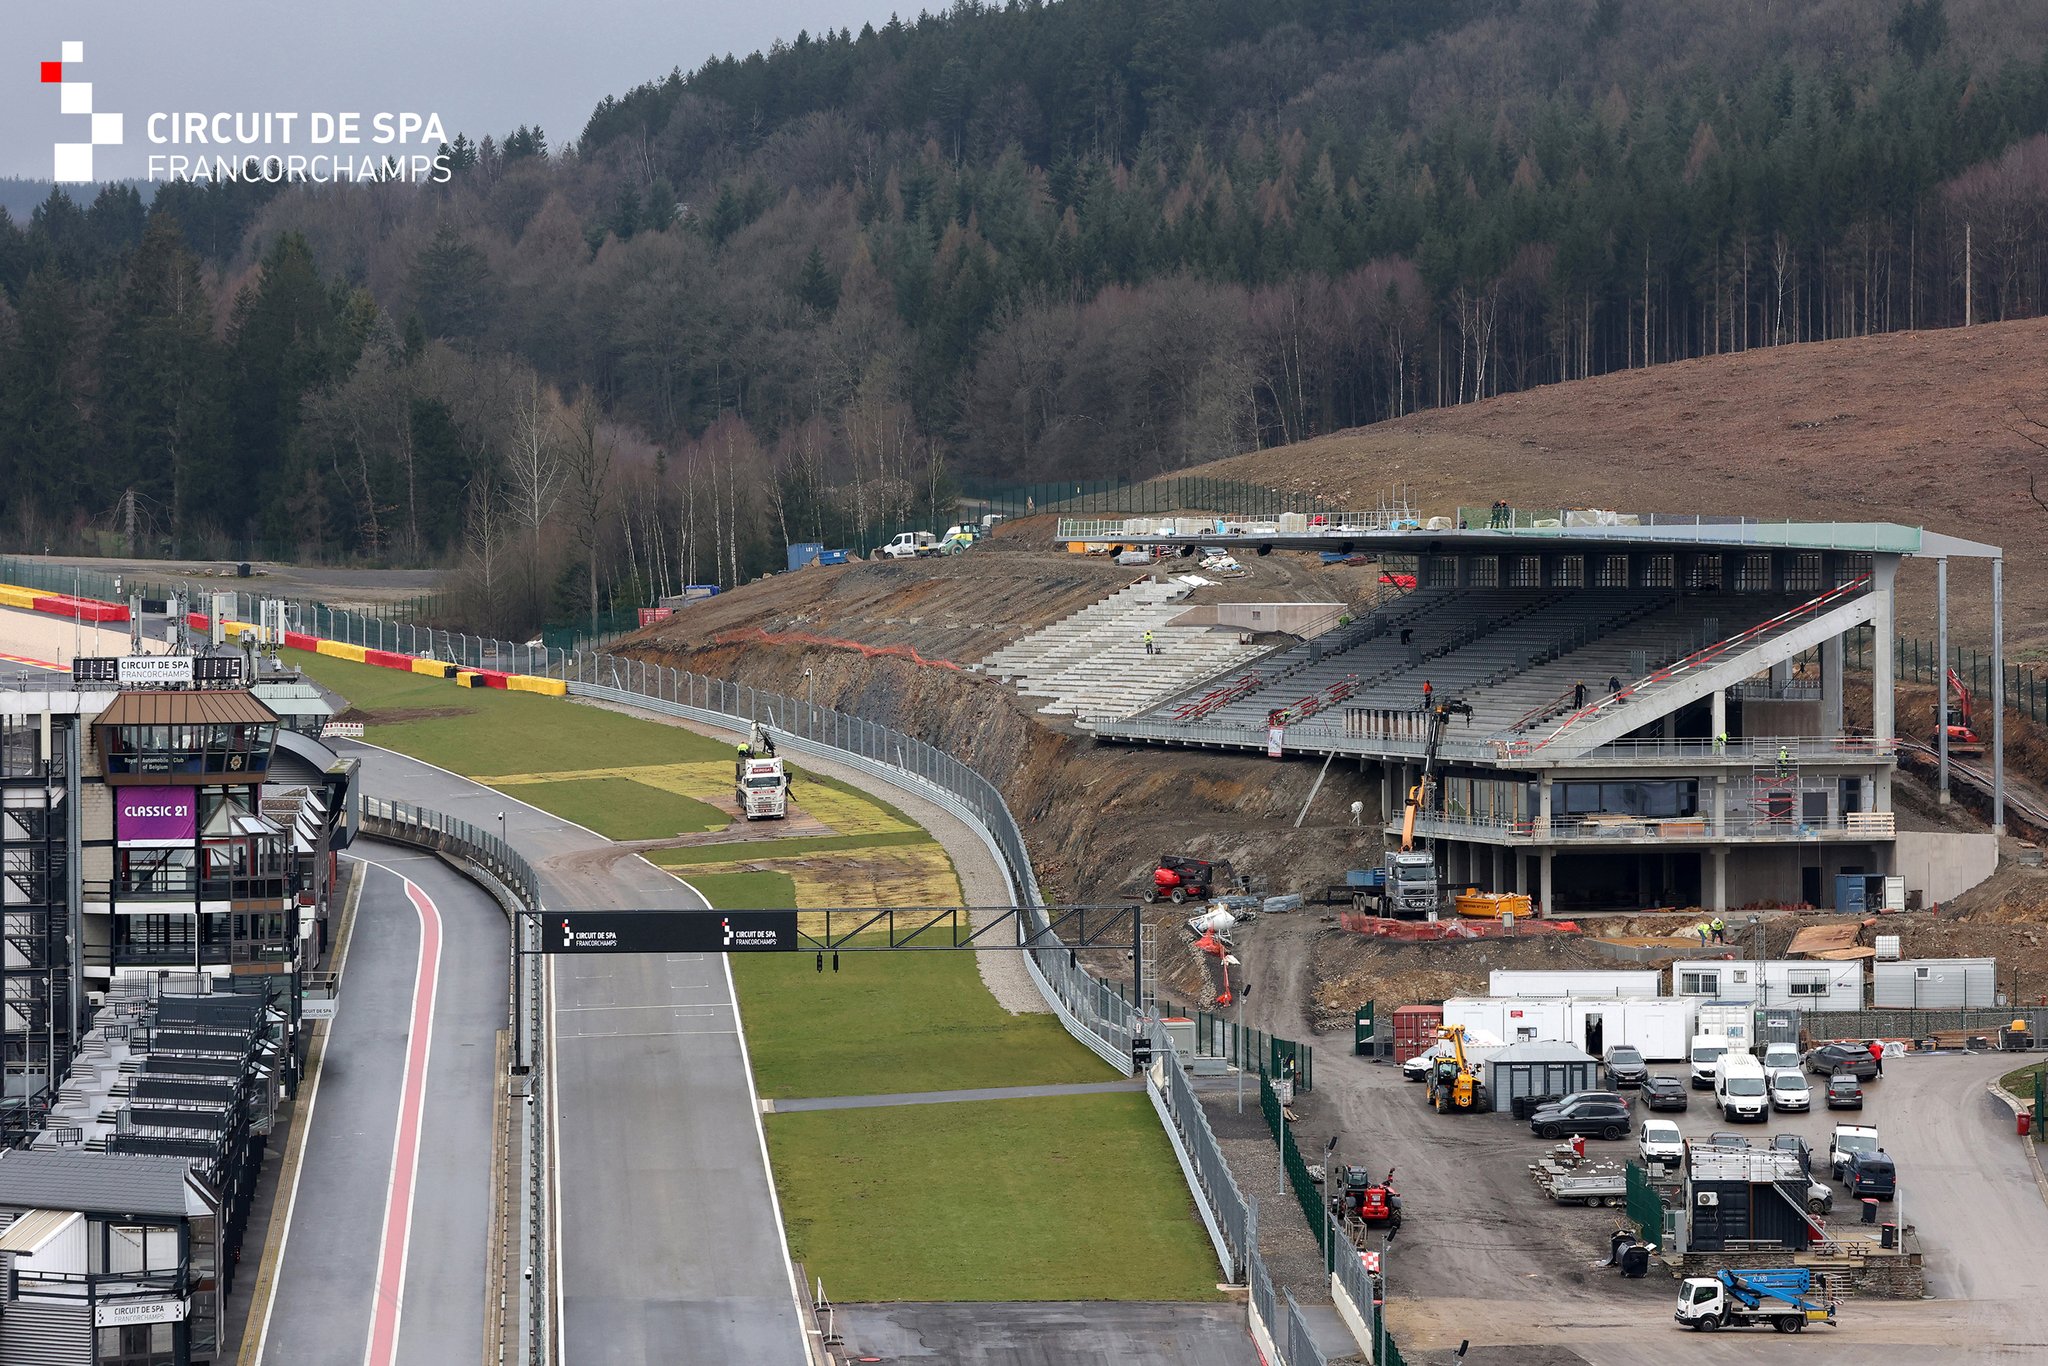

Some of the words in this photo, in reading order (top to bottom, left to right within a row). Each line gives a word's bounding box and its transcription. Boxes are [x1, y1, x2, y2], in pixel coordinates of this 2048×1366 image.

[80, 660, 115, 678] 11:15
[121, 661, 155, 669] CIRCUIT
[158, 661, 170, 669] DE
[172, 661, 189, 669] SPA
[203, 659, 240, 677] 11:15
[121, 670, 190, 678] FRANCORCHAMPS
[124, 806, 172, 817] CLASSIC
[175, 805, 188, 816] 21
[114, 1307, 140, 1315] CIRCUIT
